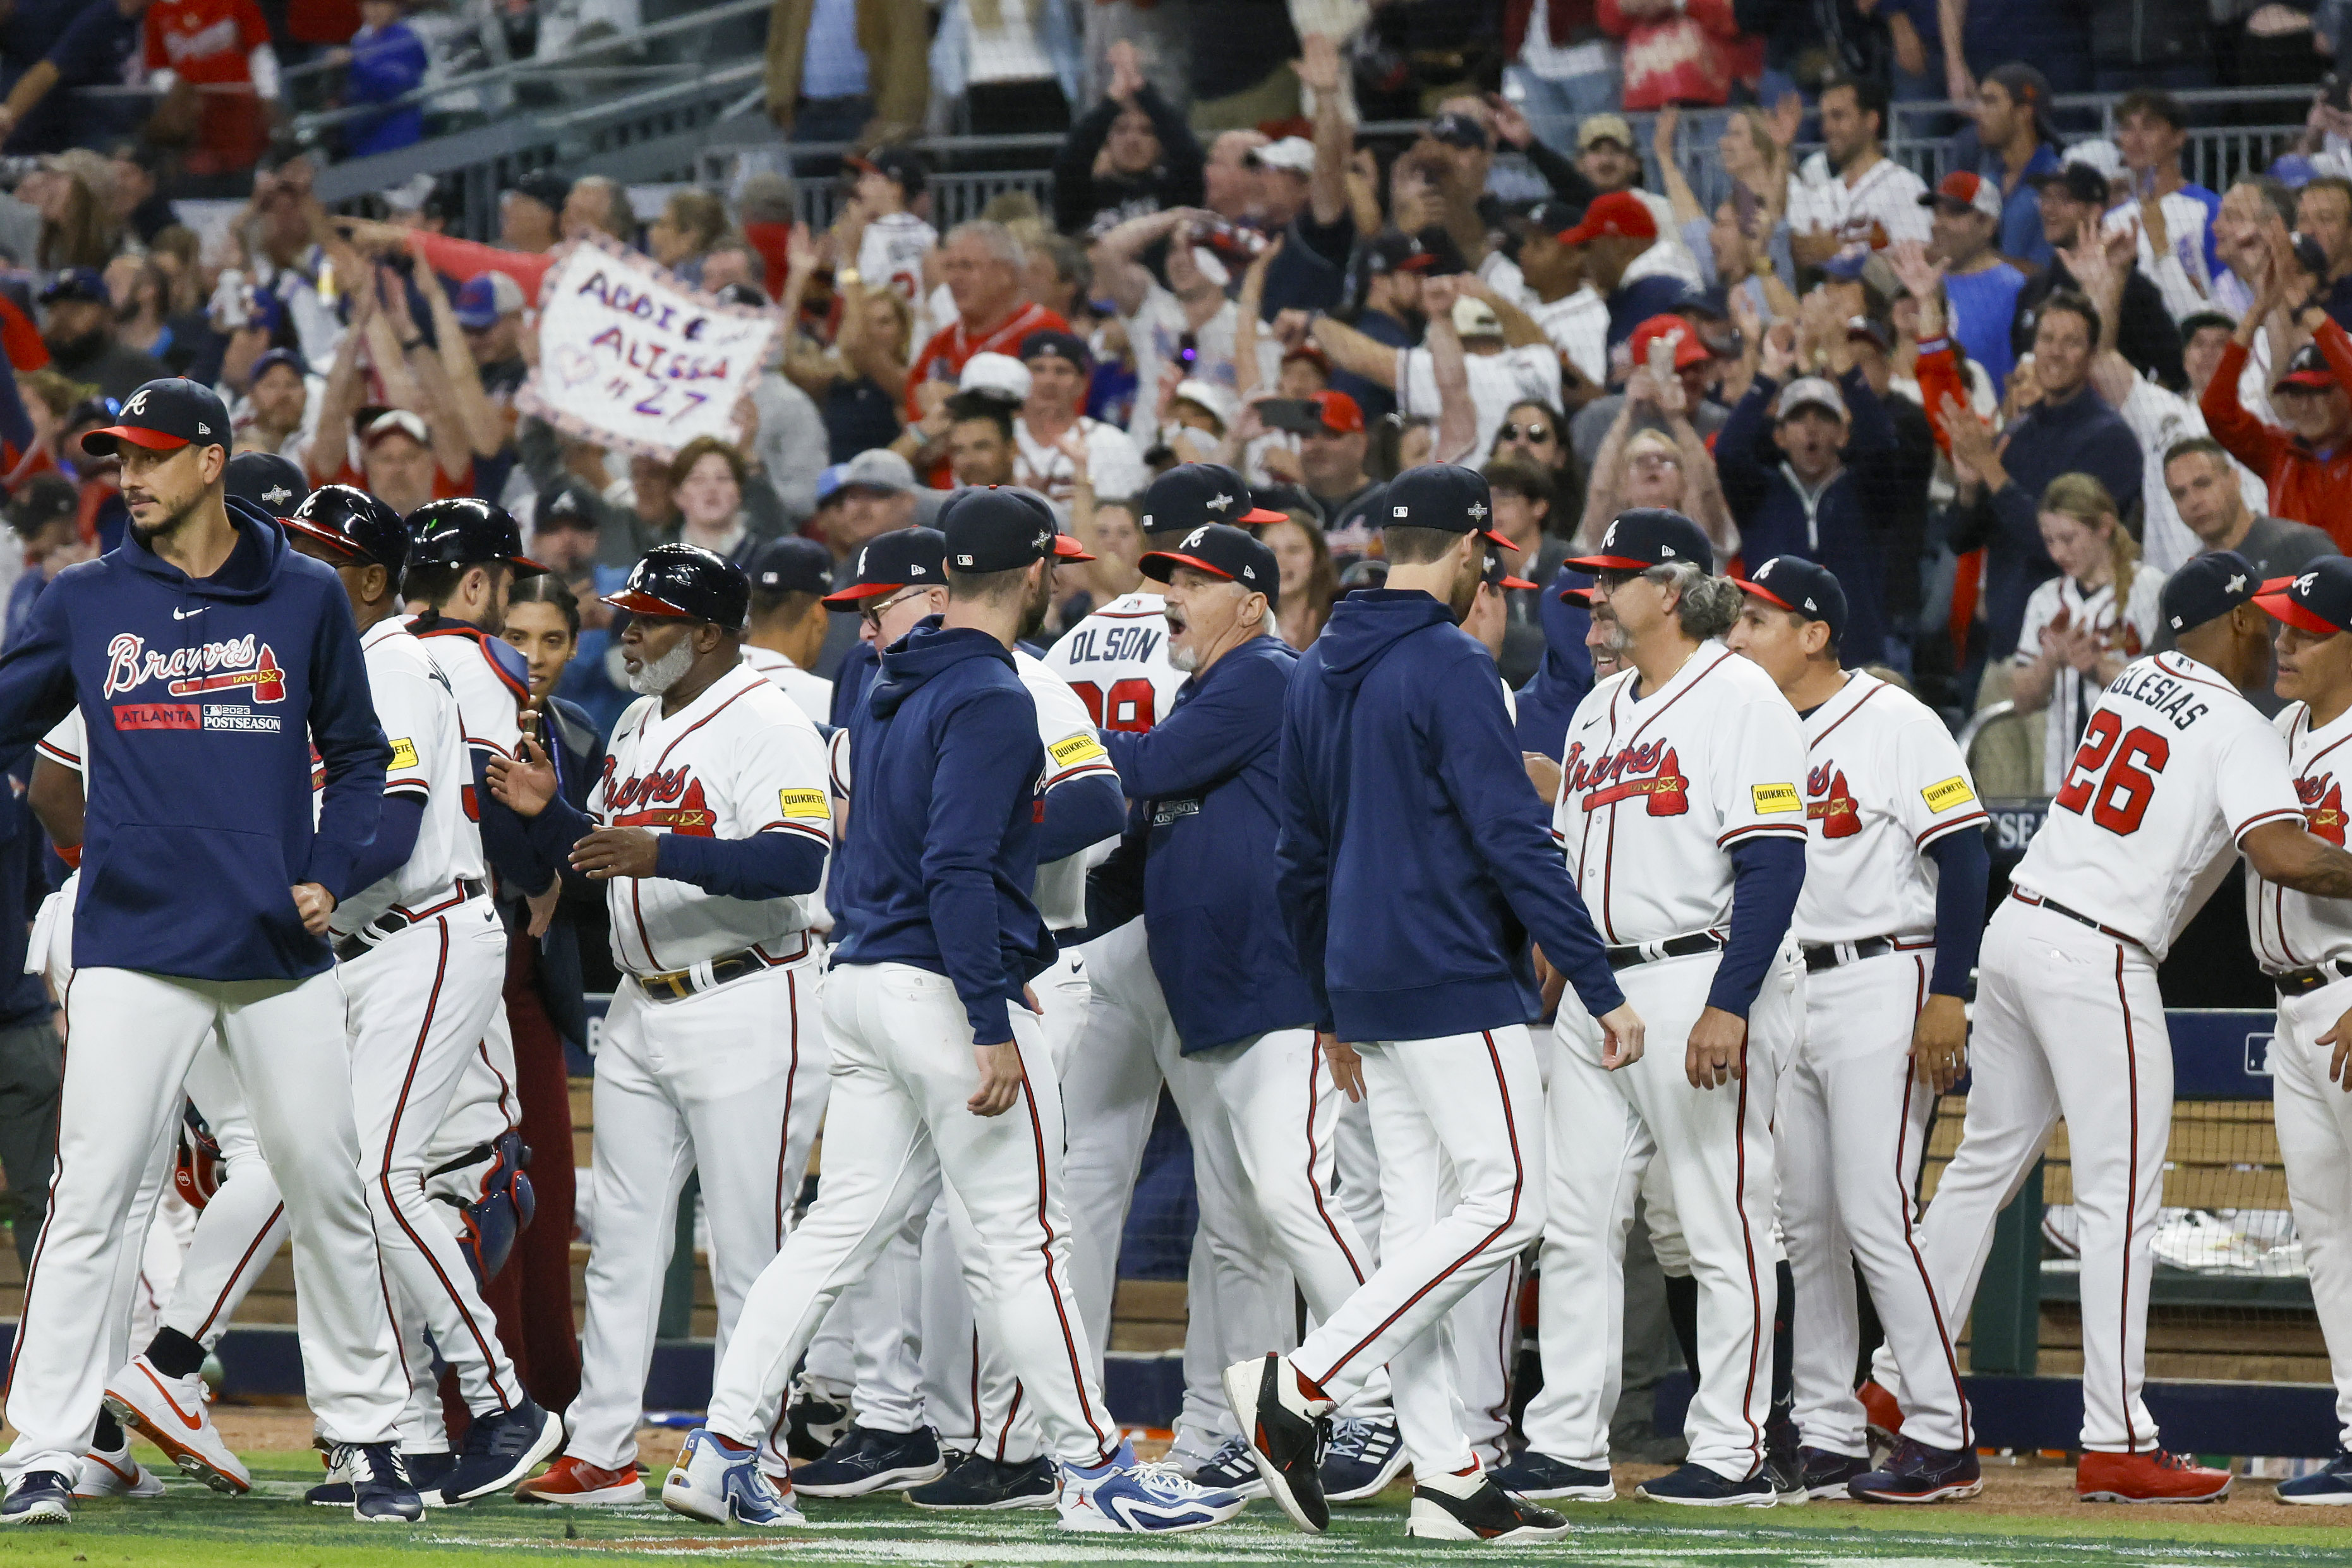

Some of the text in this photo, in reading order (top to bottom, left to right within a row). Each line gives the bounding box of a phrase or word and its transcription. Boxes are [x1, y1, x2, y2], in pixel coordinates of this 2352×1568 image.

[1070, 627, 1162, 665] OLSON
[103, 633, 256, 700] Braves
[121, 710, 195, 723] ATLANTA
[222, 706, 250, 715] 2023
[203, 716, 280, 730] POSTSEASON
[1055, 738, 1094, 758] QUIKRETE
[1562, 737, 1667, 808] Braves
[2056, 708, 2170, 837] 26
[784, 793, 825, 806] QUIKRETE
[1756, 789, 1795, 801] QUIKRETE
[1927, 781, 1967, 802] QUIKRETE
